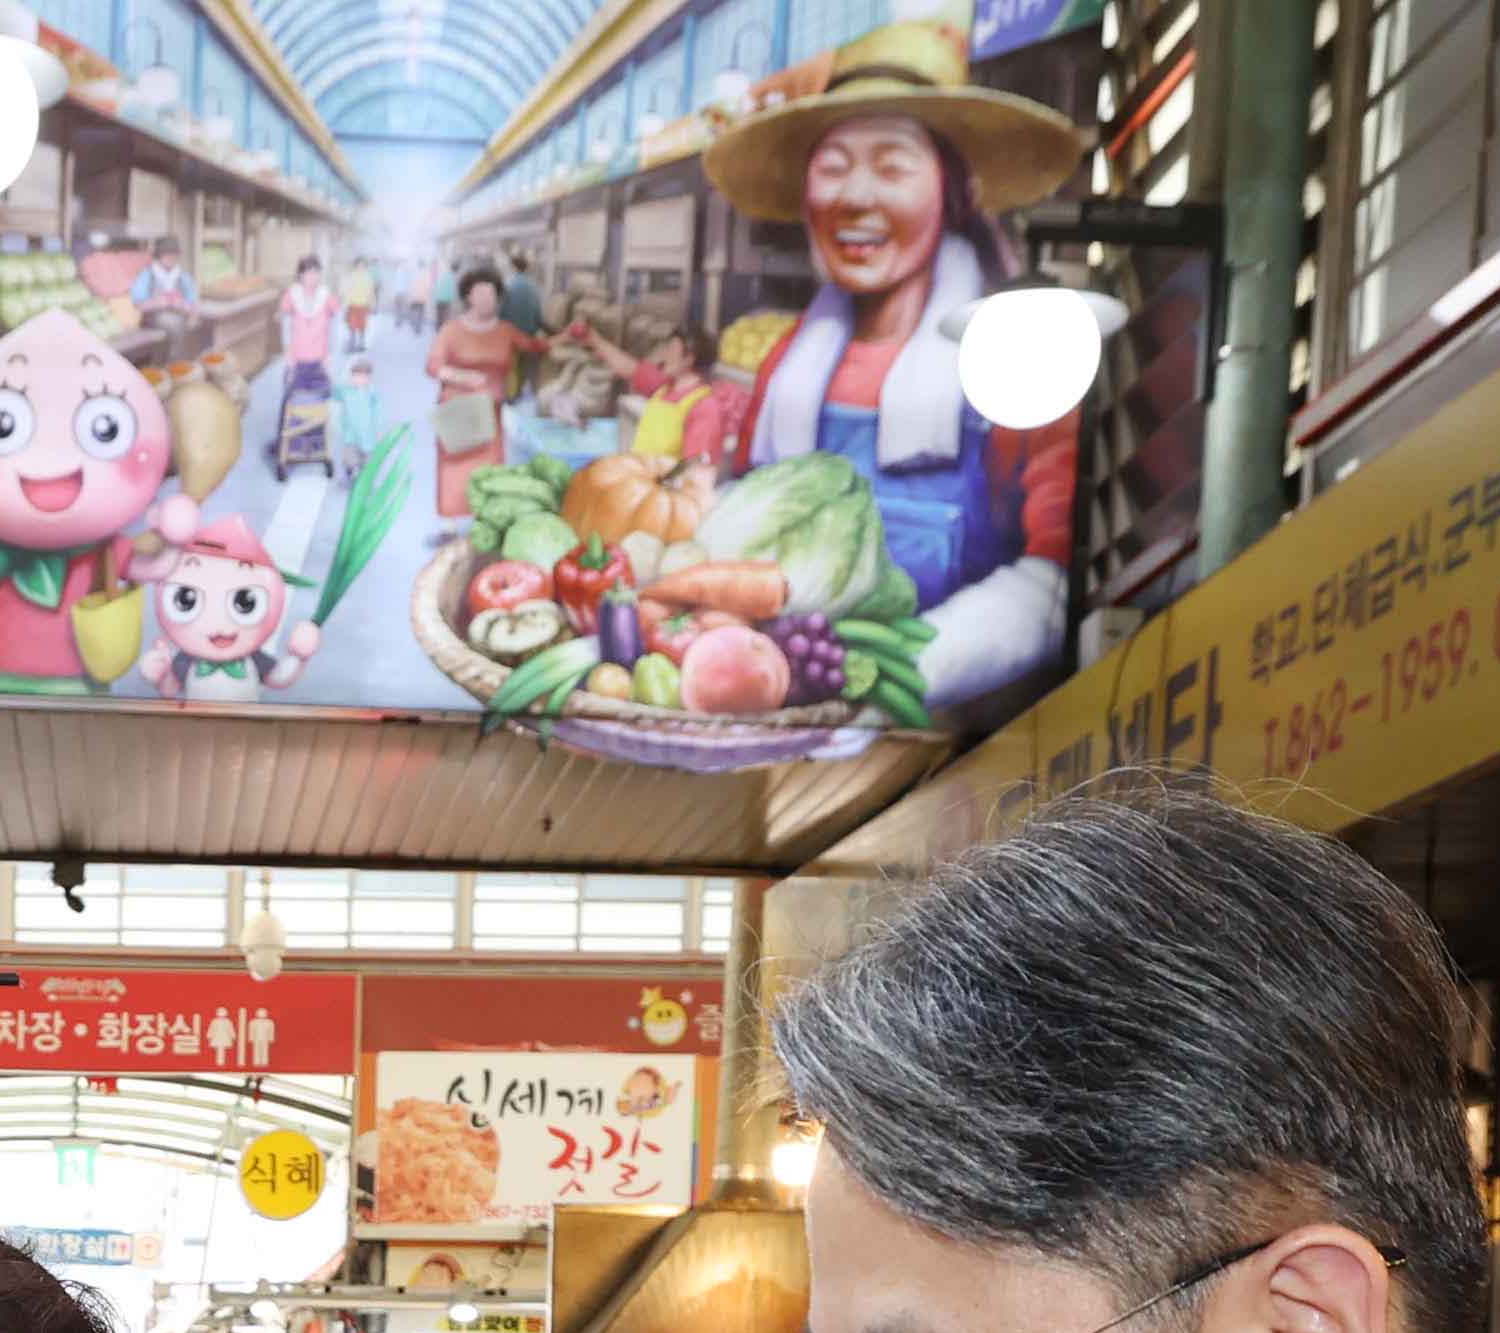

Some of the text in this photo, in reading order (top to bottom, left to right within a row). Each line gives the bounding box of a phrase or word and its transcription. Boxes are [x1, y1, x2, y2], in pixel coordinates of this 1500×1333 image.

[446, 1068, 605, 1130] 신세계
[242, 1151, 321, 1193] 식혜
[547, 1124, 663, 1197] 젓갈
